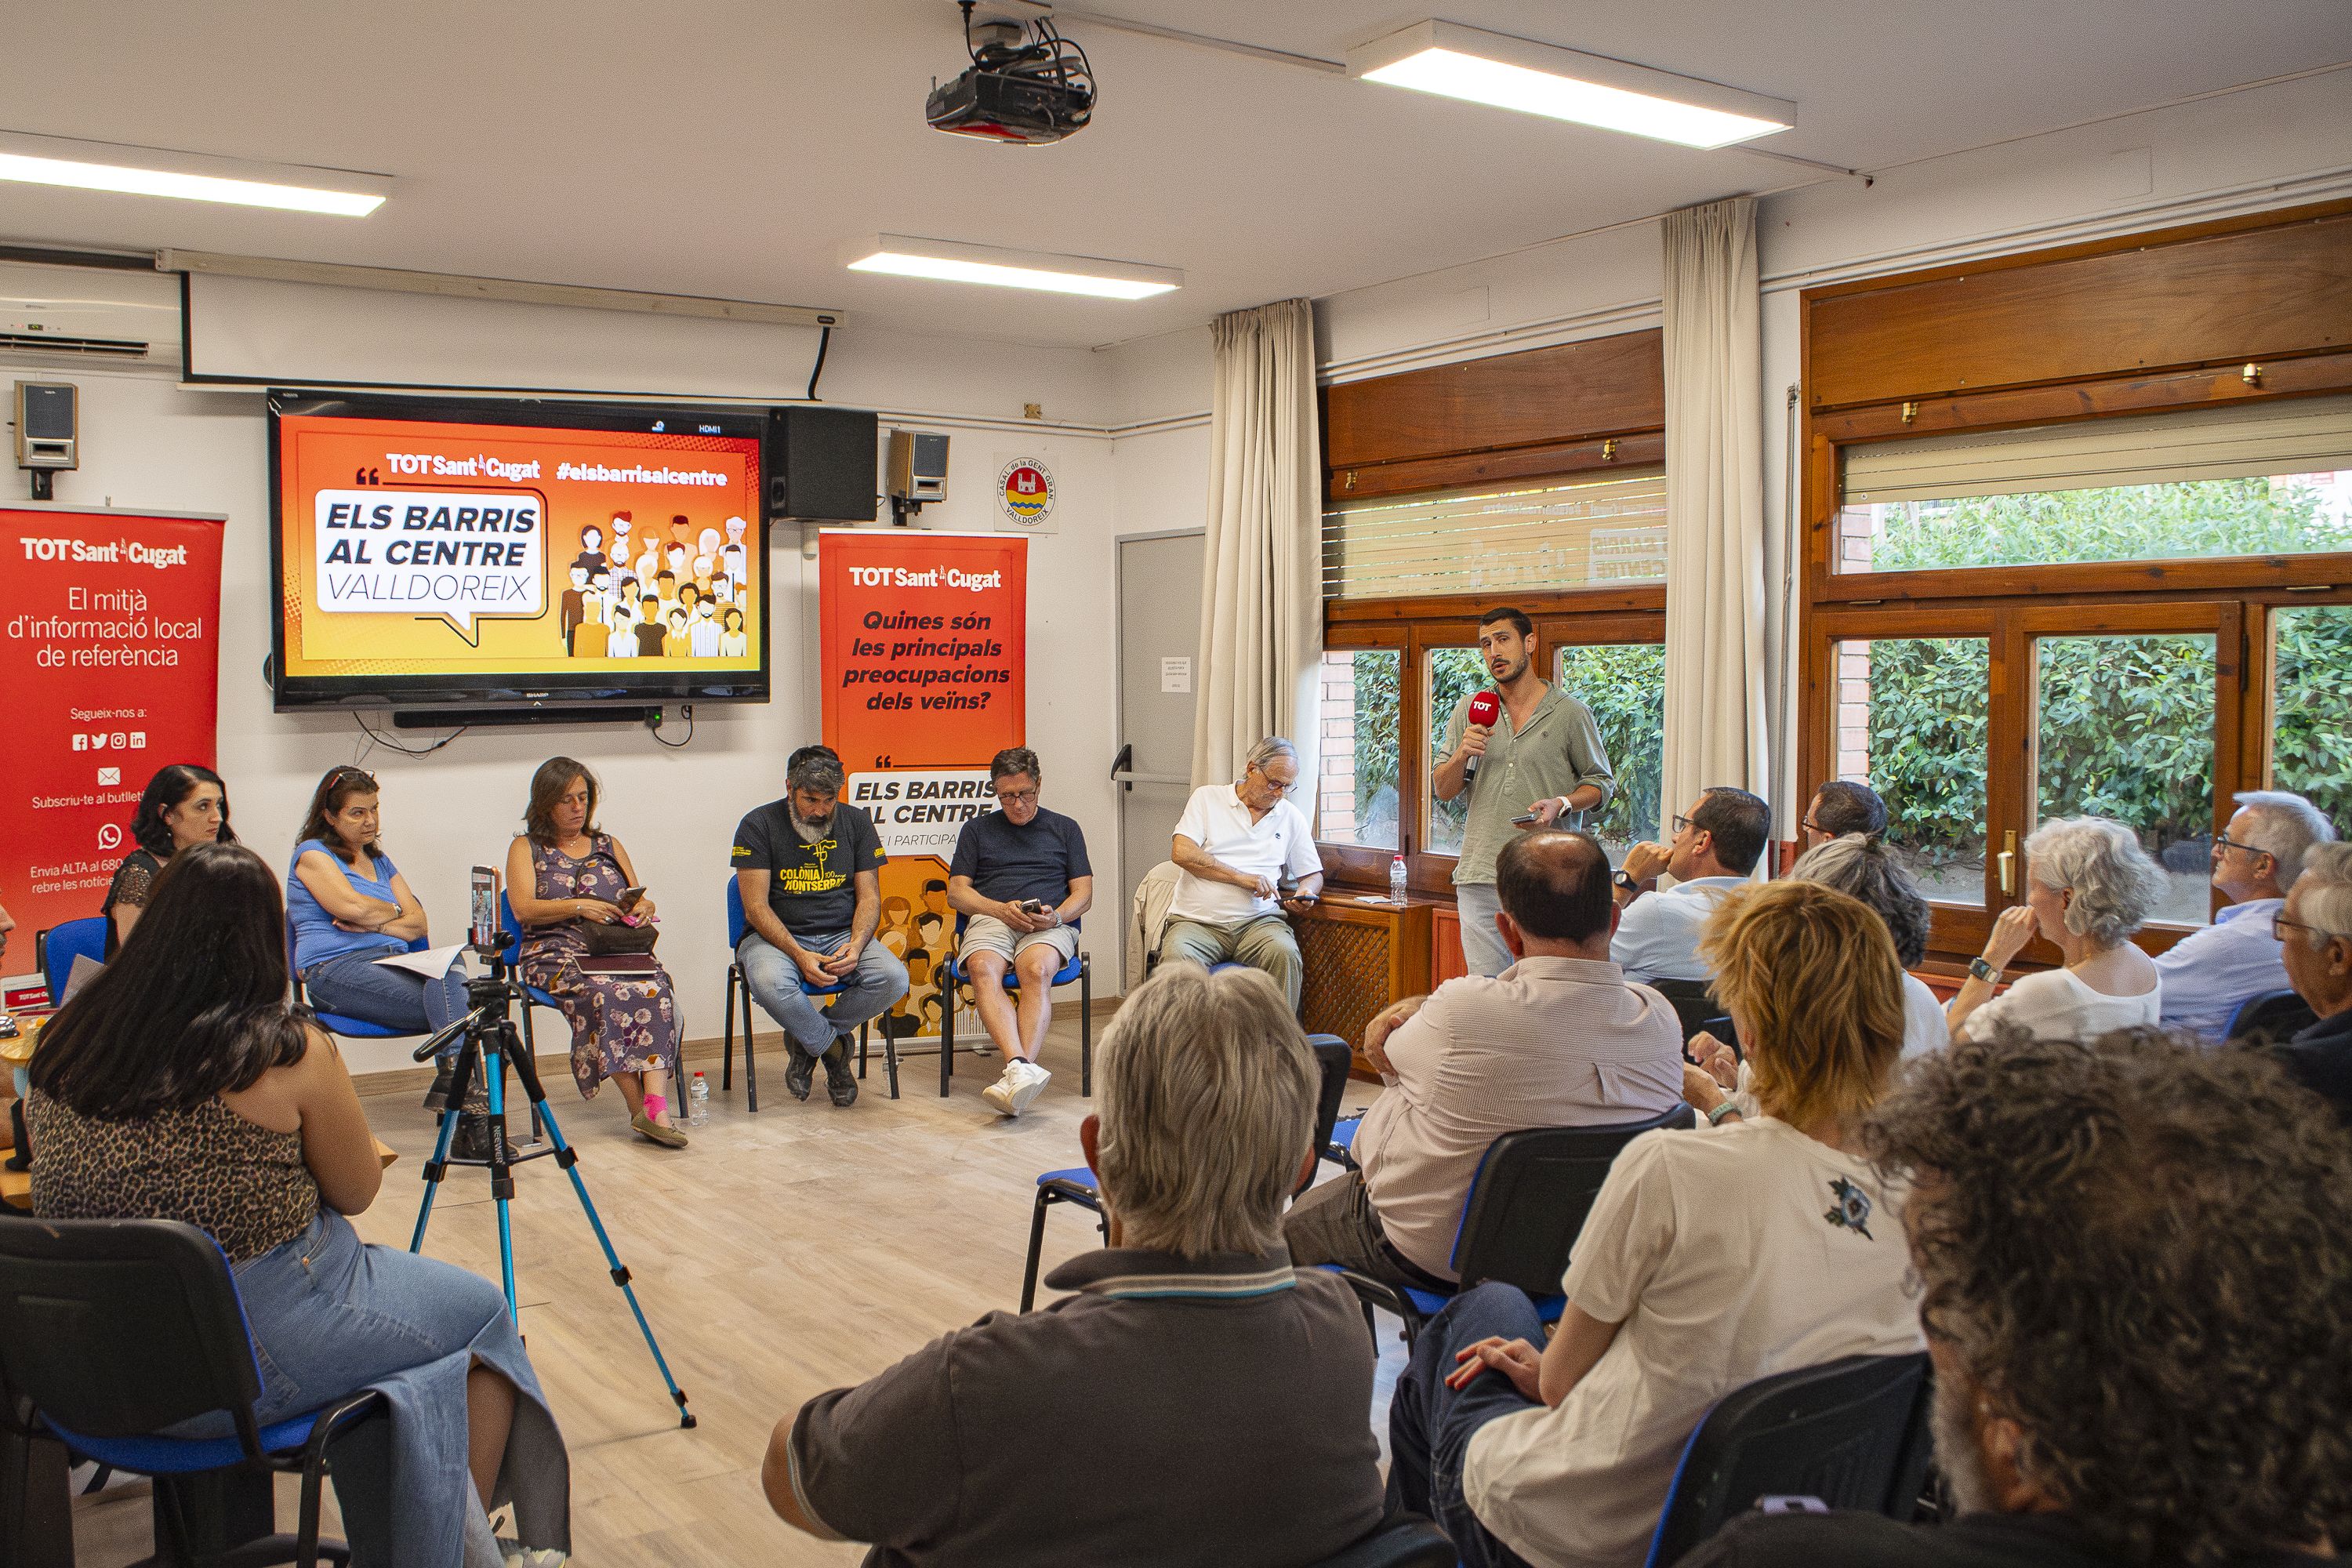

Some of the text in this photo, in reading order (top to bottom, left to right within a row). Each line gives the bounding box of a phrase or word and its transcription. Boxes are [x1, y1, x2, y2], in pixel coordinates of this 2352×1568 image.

[485, 458, 541, 482] Cugat
[556, 462, 728, 486] #elsbarrisalcentre
[999, 470, 1011, 496] CASAL
[1028, 459, 1047, 474] GENT
[1045, 474, 1054, 500] GRAN
[326, 503, 536, 533] ELS BARRIS
[1006, 506, 1049, 524] VALLDOREIX
[128, 542, 187, 569] Cugat
[325, 539, 527, 567] AL CENTRE
[328, 574, 531, 601] VALLDOREIX
[947, 568, 1001, 592] Cugat
[68, 586, 147, 616] El mitjà
[154, 616, 202, 640] local
[863, 610, 992, 630] Quines són
[36, 644, 179, 667] de referència
[851, 637, 1003, 661] les principals
[842, 664, 1011, 688] preocupacions
[866, 691, 992, 710] dels veïns?
[1474, 701, 1491, 711] TOT
[70, 707, 147, 722] Segueix-nos a:
[31, 793, 95, 809] Subscriu-te
[96, 793, 105, 804] al
[855, 780, 997, 800] ELS BARRIS
[894, 804, 993, 824] CENTRE
[894, 833, 957, 846] PARTICIPA
[30, 866, 60, 878] Envia
[61, 862, 89, 875] ALTA
[89, 861, 99, 872] al
[780, 866, 821, 880] COLÒNIA
[32, 881, 60, 894] rebre
[63, 880, 78, 890] les
